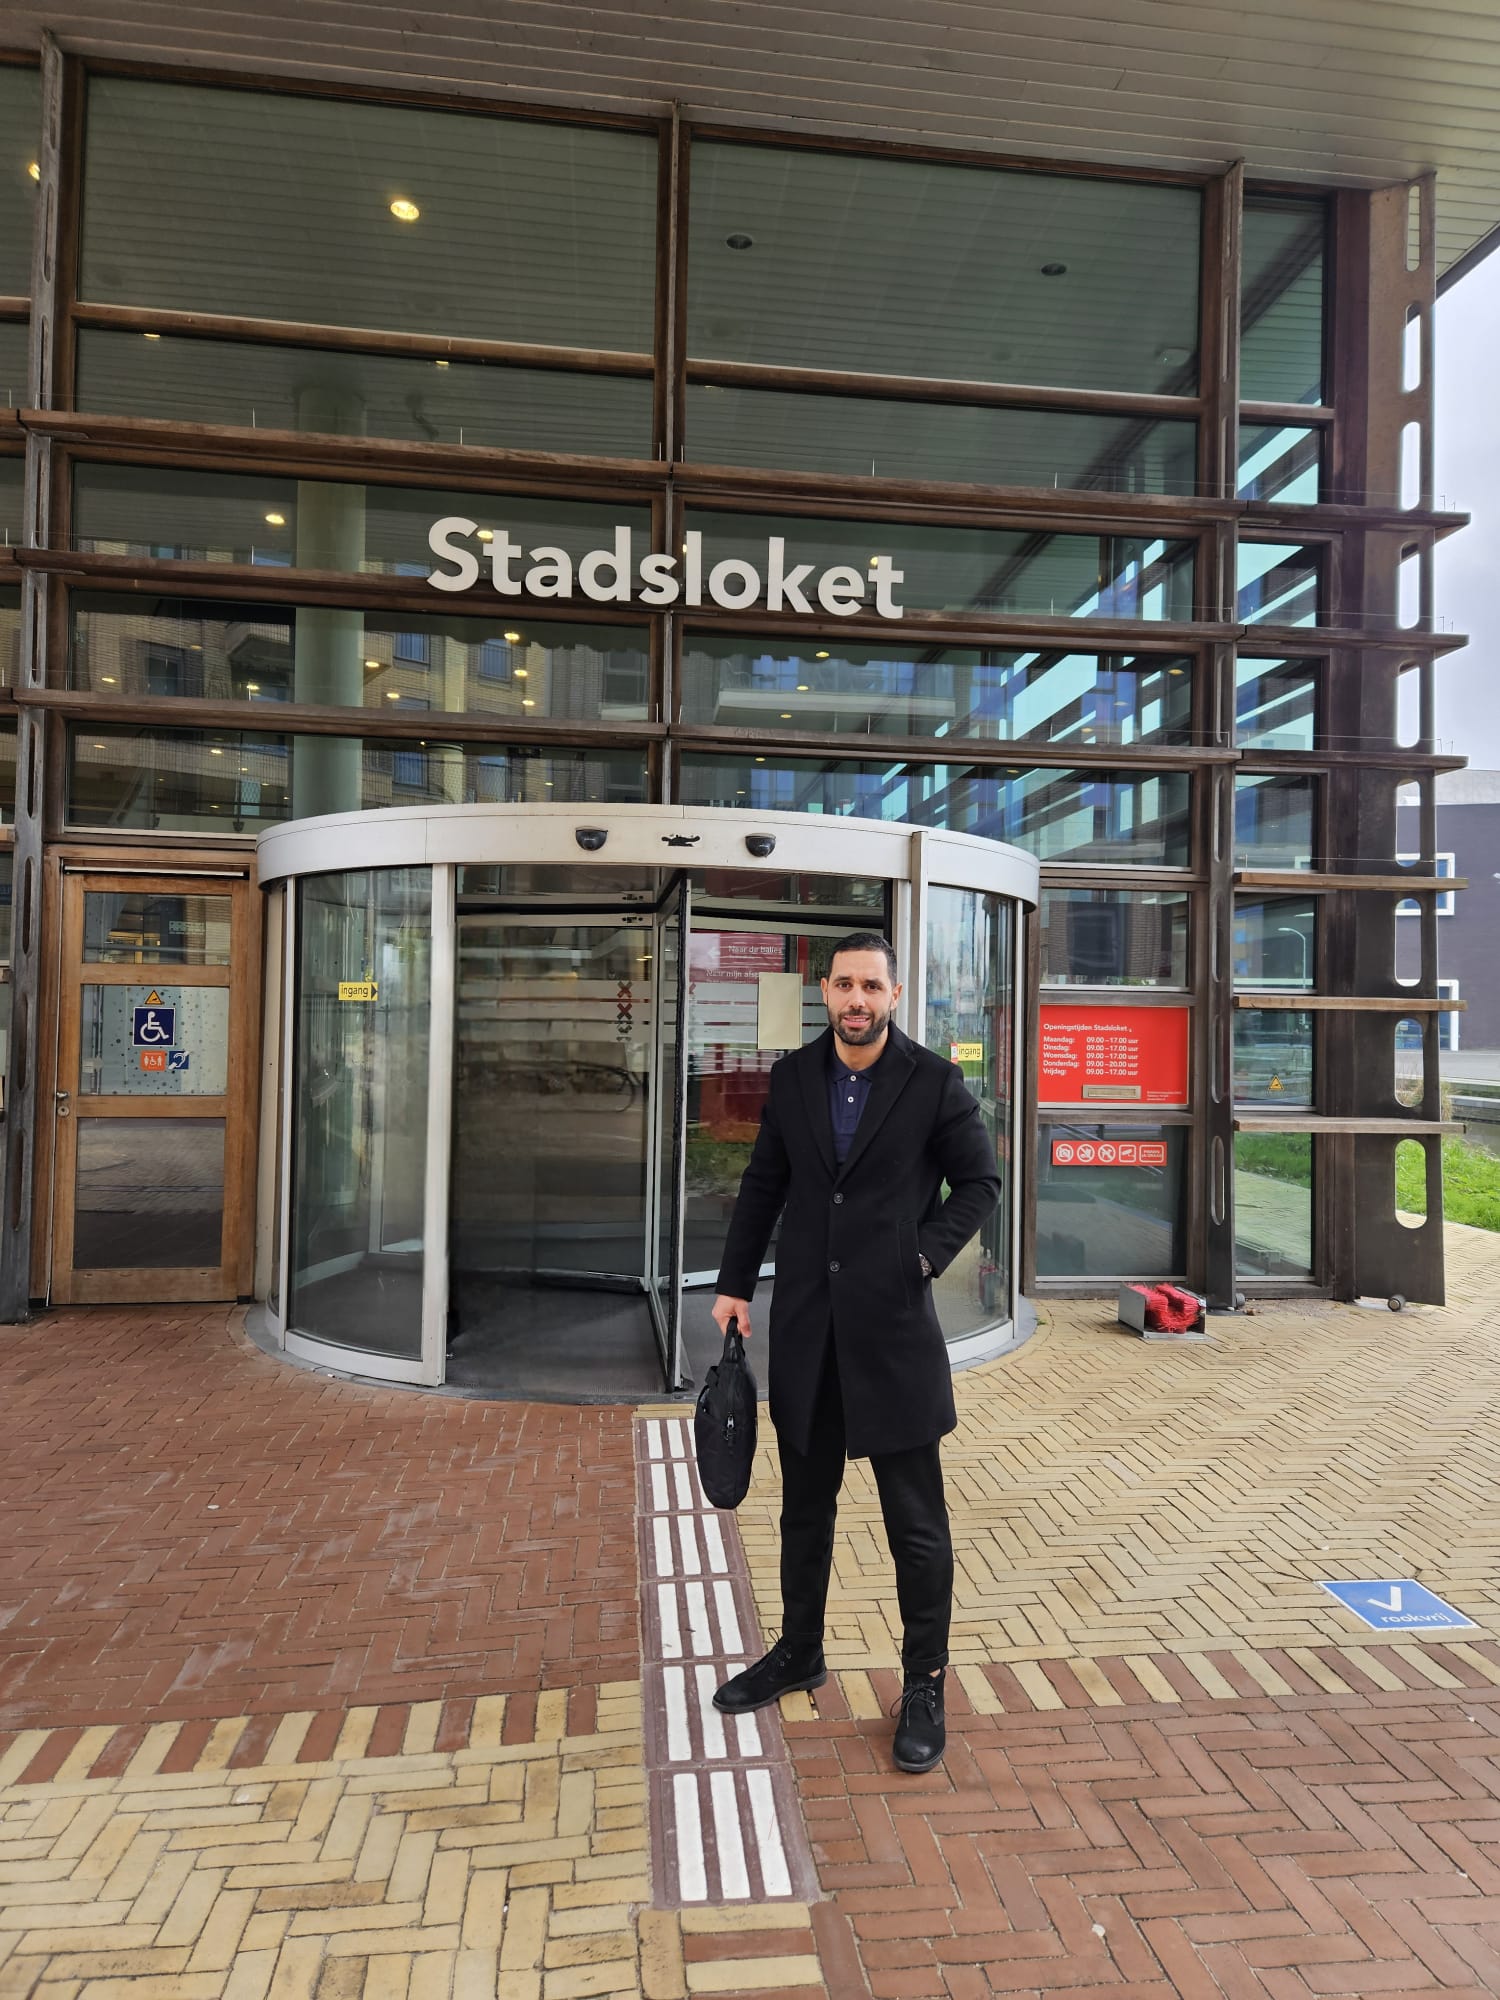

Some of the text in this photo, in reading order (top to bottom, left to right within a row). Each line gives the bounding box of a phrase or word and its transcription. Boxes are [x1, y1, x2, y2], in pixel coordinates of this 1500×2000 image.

[426, 516, 904, 619] Stadsloket
[341, 984, 369, 998] ingang
[1043, 1023, 1128, 1032] Openingstijden Stadsloket
[1380, 1612, 1452, 1623] rookvrij
